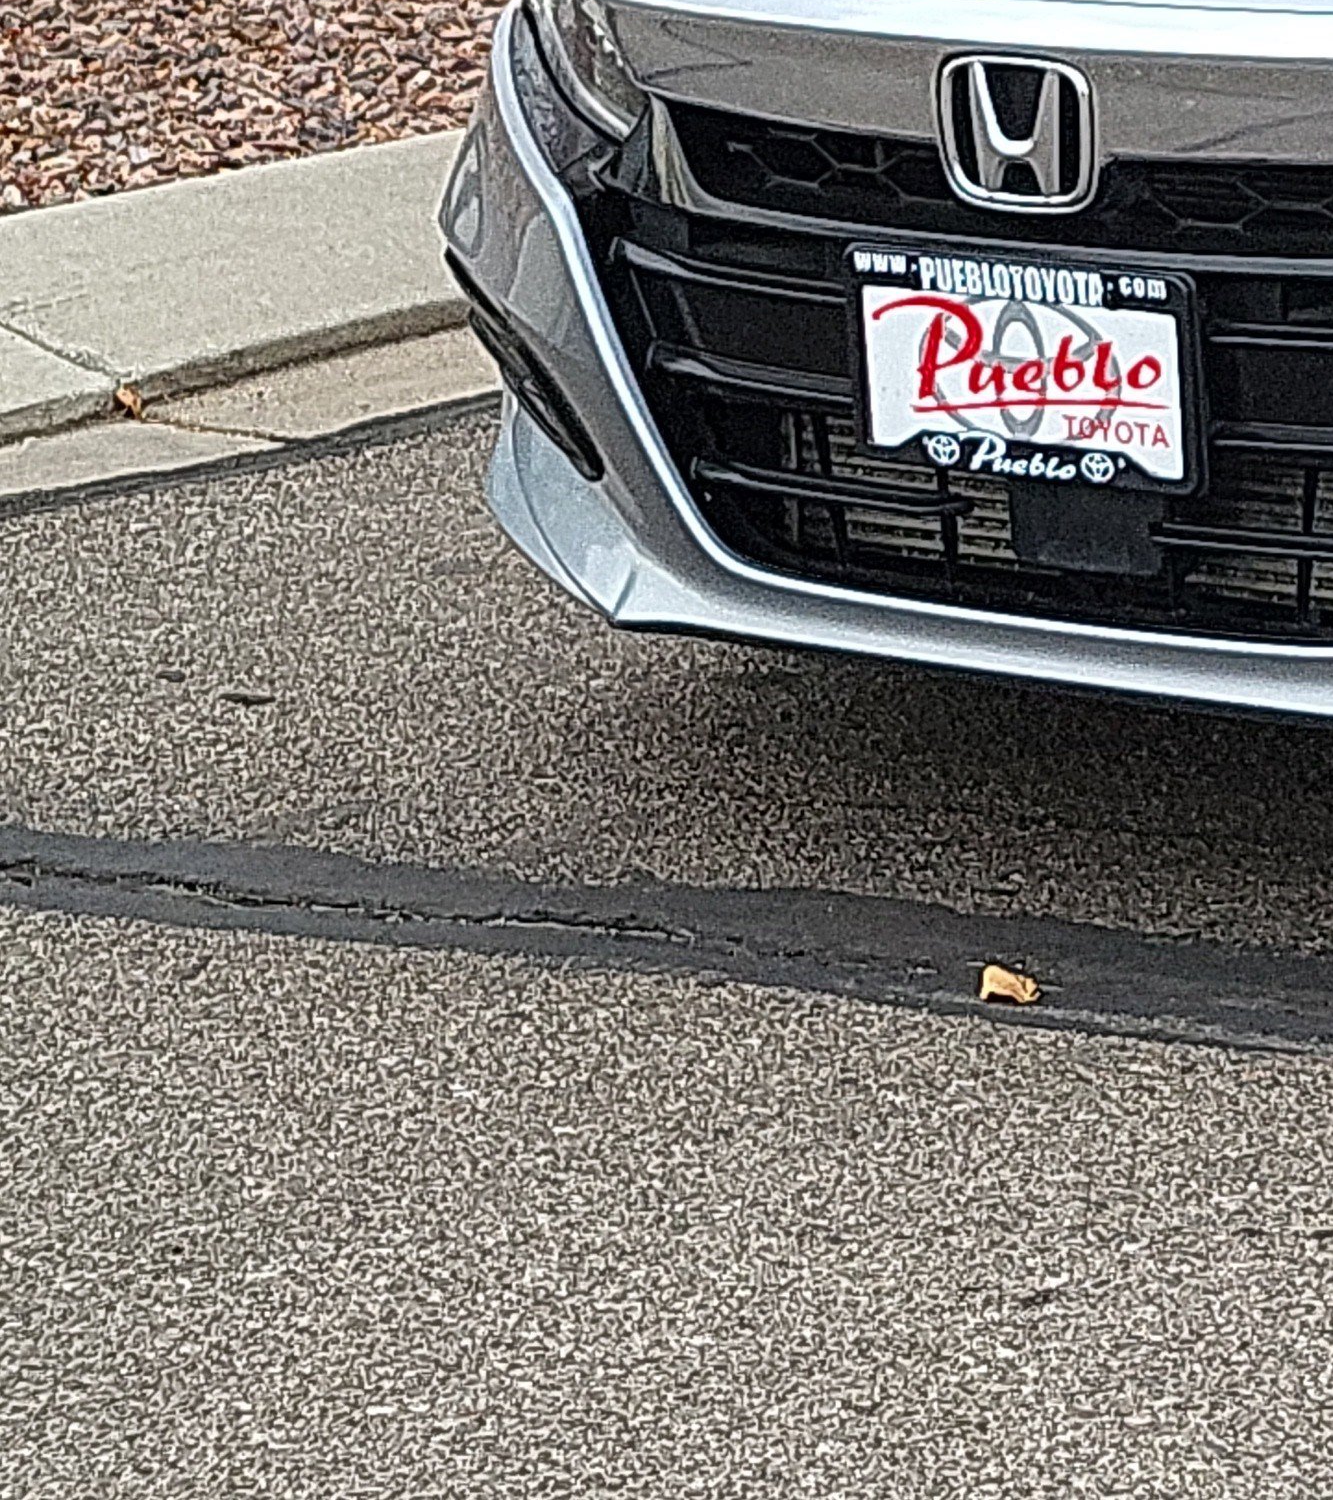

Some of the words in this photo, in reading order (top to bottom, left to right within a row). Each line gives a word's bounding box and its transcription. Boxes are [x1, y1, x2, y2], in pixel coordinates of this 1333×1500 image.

[872, 295, 1162, 400] Pueblo
[957, 429, 1077, 480] Pueblo
[1062, 413, 1171, 449] TOYOTA
